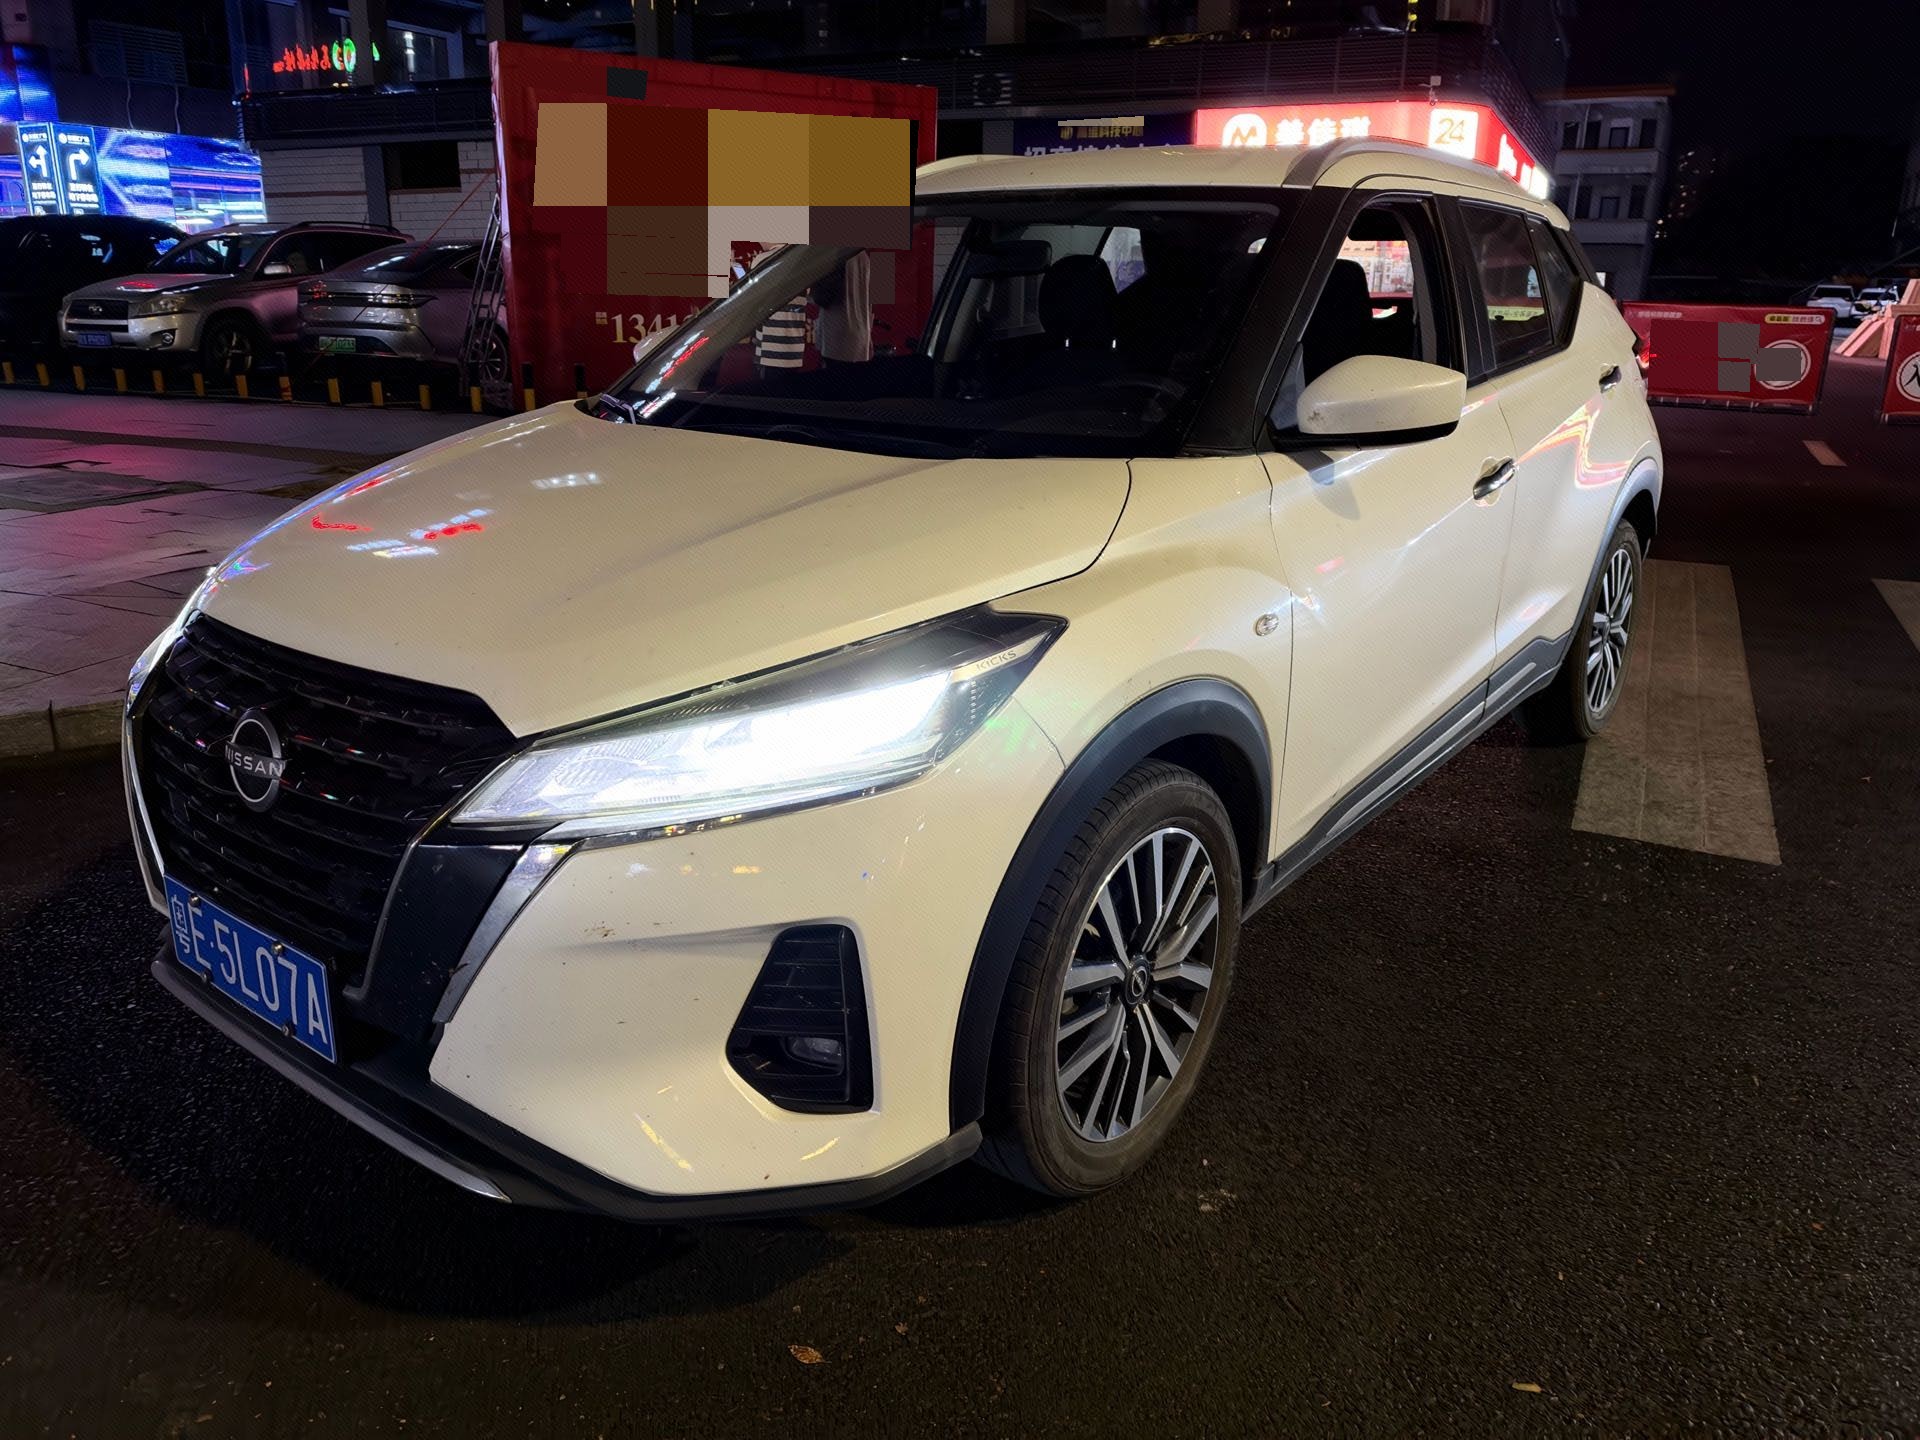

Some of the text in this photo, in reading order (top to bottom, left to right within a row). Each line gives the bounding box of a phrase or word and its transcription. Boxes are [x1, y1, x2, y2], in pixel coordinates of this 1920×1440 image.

[1435, 117, 1465, 144] 24
[976, 650, 1017, 671] KICKS
[225, 744, 283, 777] NISSAN
